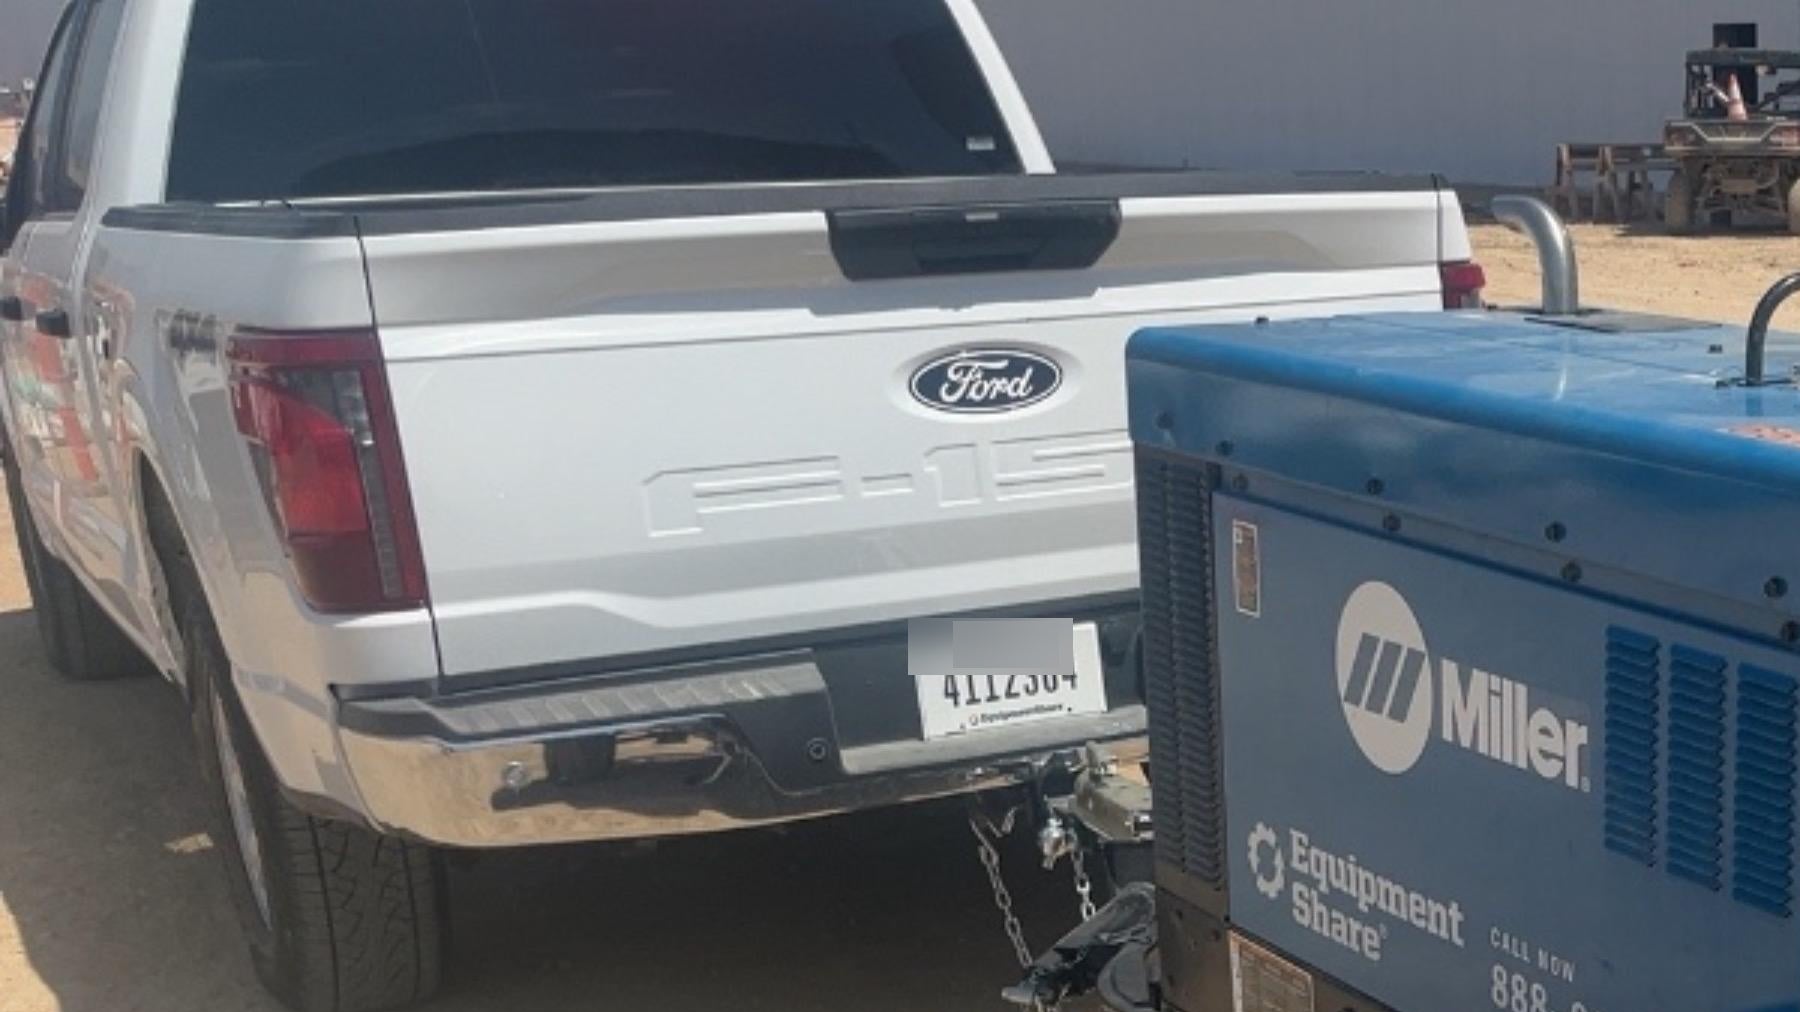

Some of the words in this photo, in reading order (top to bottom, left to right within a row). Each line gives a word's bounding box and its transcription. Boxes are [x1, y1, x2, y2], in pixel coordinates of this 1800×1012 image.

[938, 353, 1034, 404] Ford
[1289, 827, 1465, 948] Equipment
[1490, 926, 1531, 963] CALL
[1538, 948, 1577, 983] NOW
